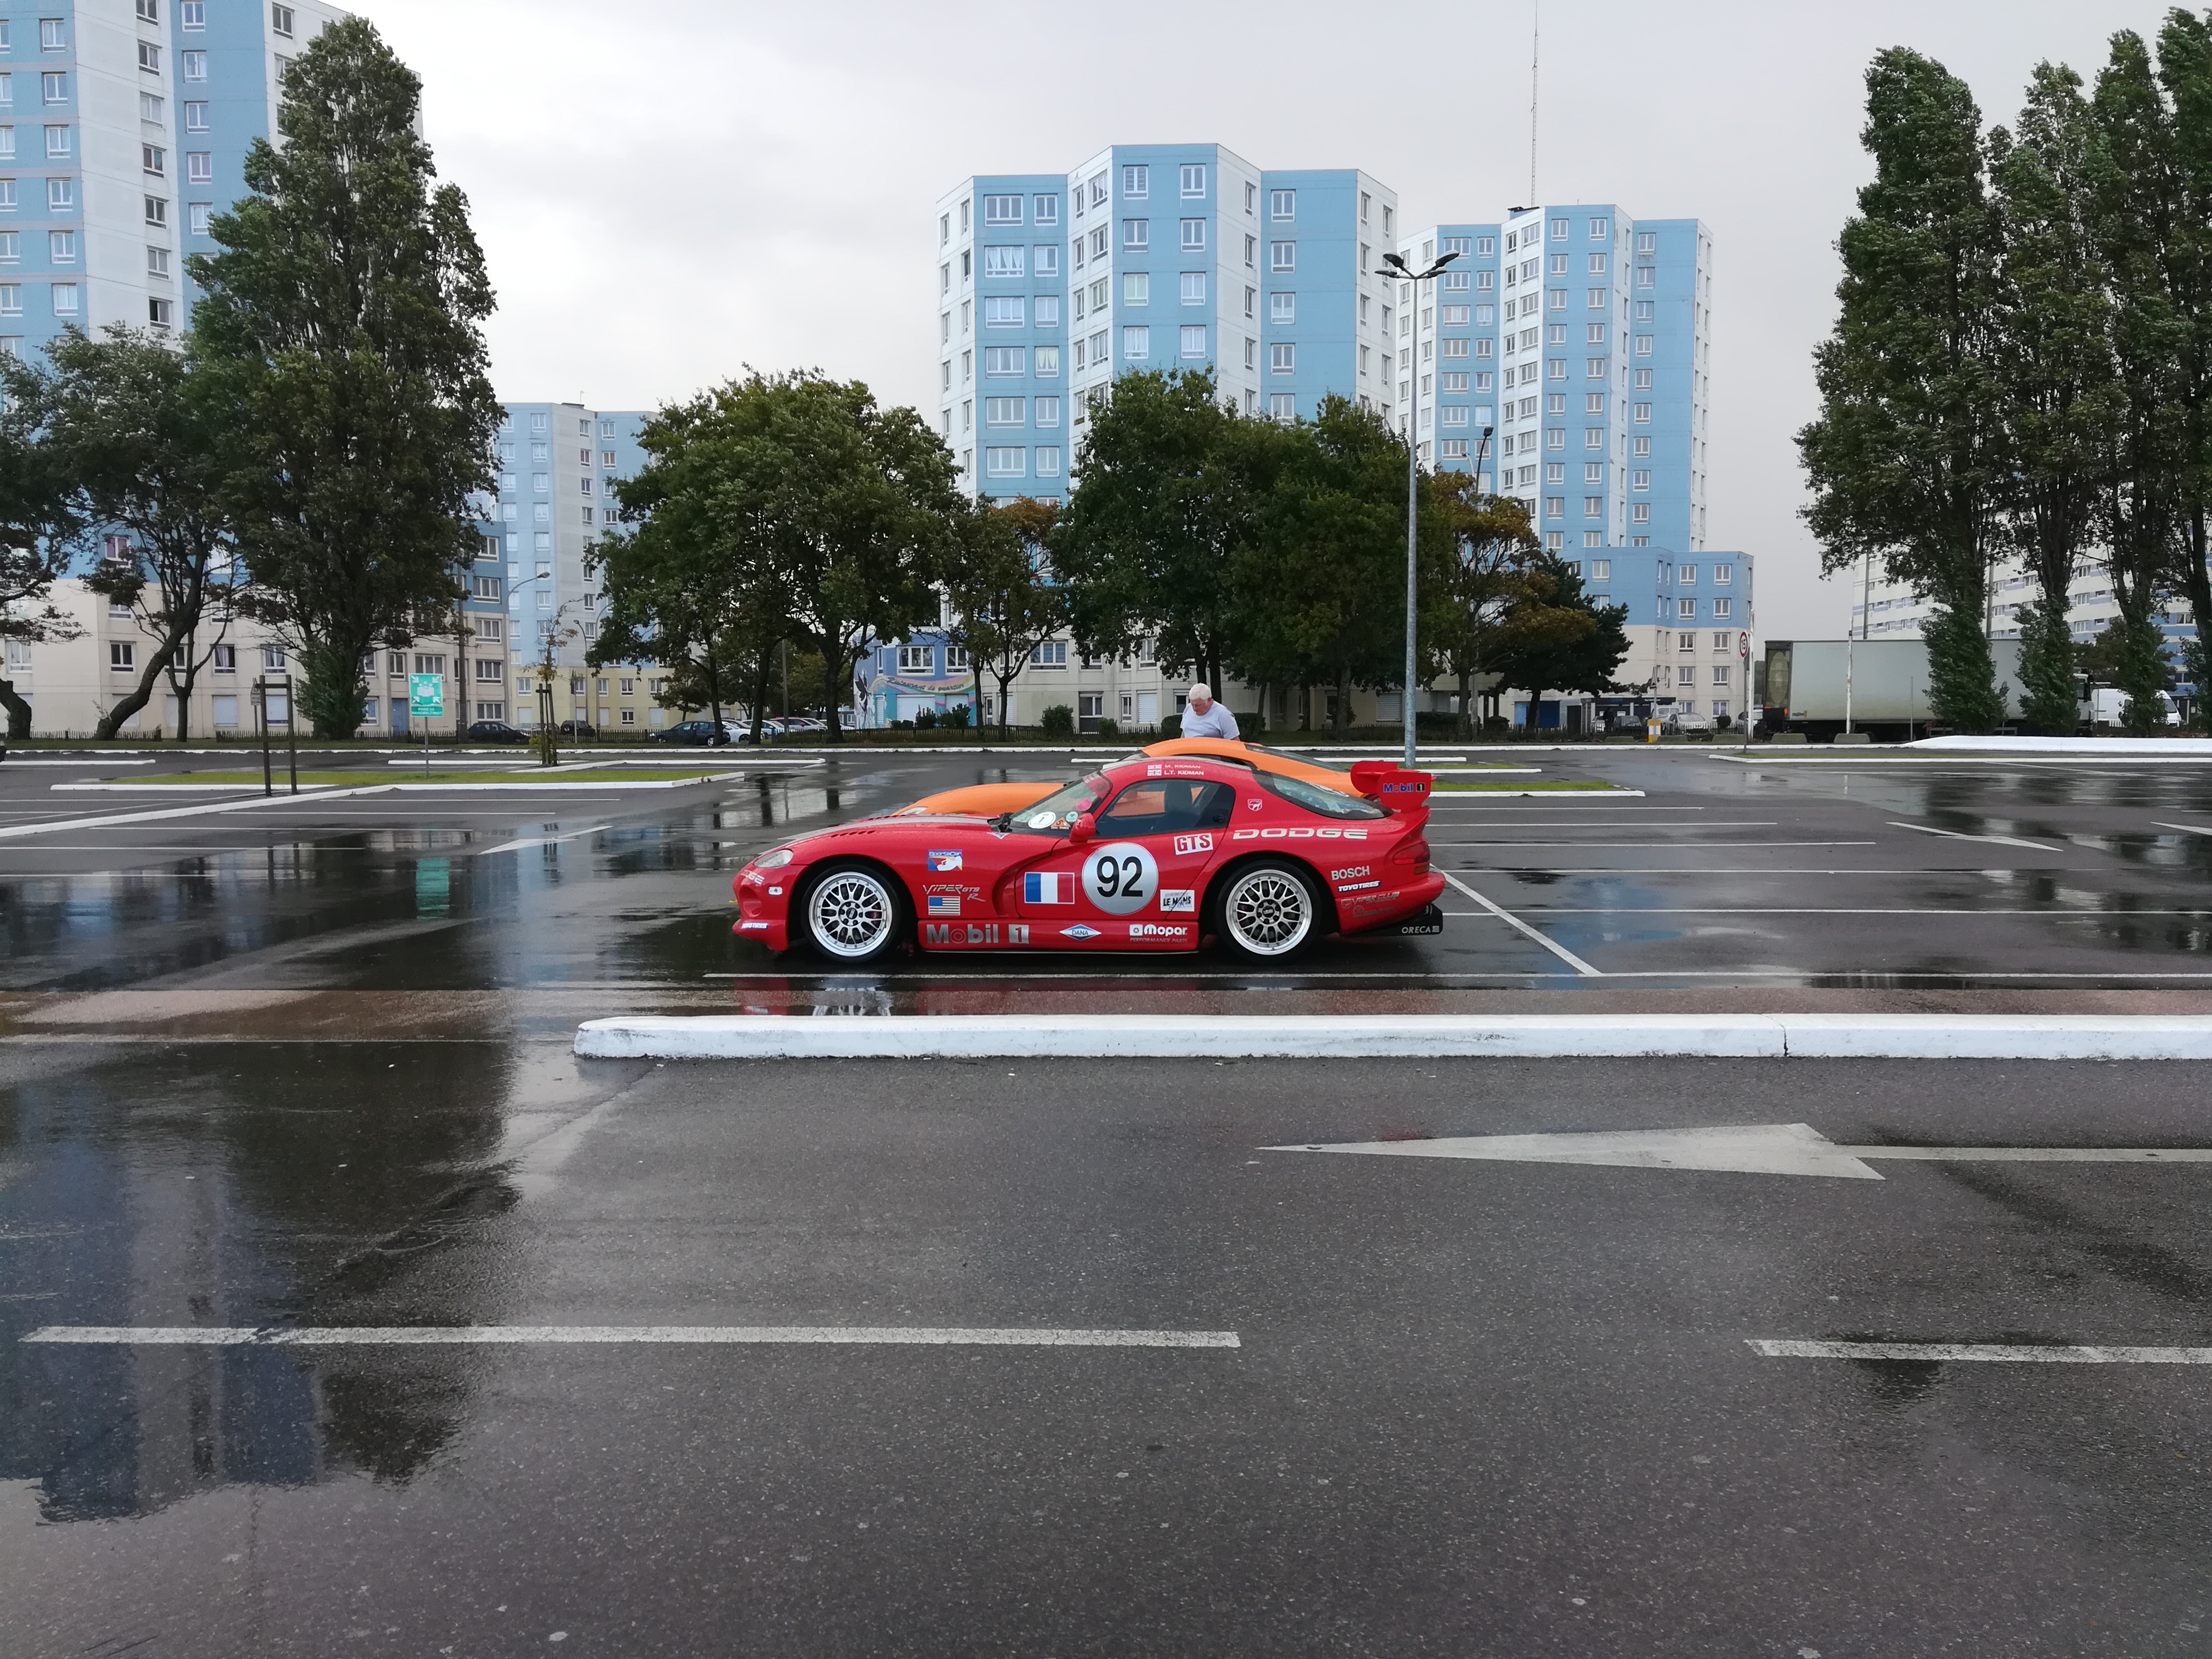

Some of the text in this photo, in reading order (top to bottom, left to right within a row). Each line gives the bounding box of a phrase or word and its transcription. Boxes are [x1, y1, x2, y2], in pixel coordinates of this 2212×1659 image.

[1383, 783, 1414, 793] Mobil
[1233, 828, 1368, 840] DODGE
[1176, 834, 1210, 852] GTS
[1096, 855, 1143, 897] 92
[1331, 865, 1370, 881] BOSCH
[1338, 884, 1359, 892] TOYO
[967, 893, 986, 902] R
[1163, 898, 1171, 906] LE
[926, 924, 999, 944] Mobil
